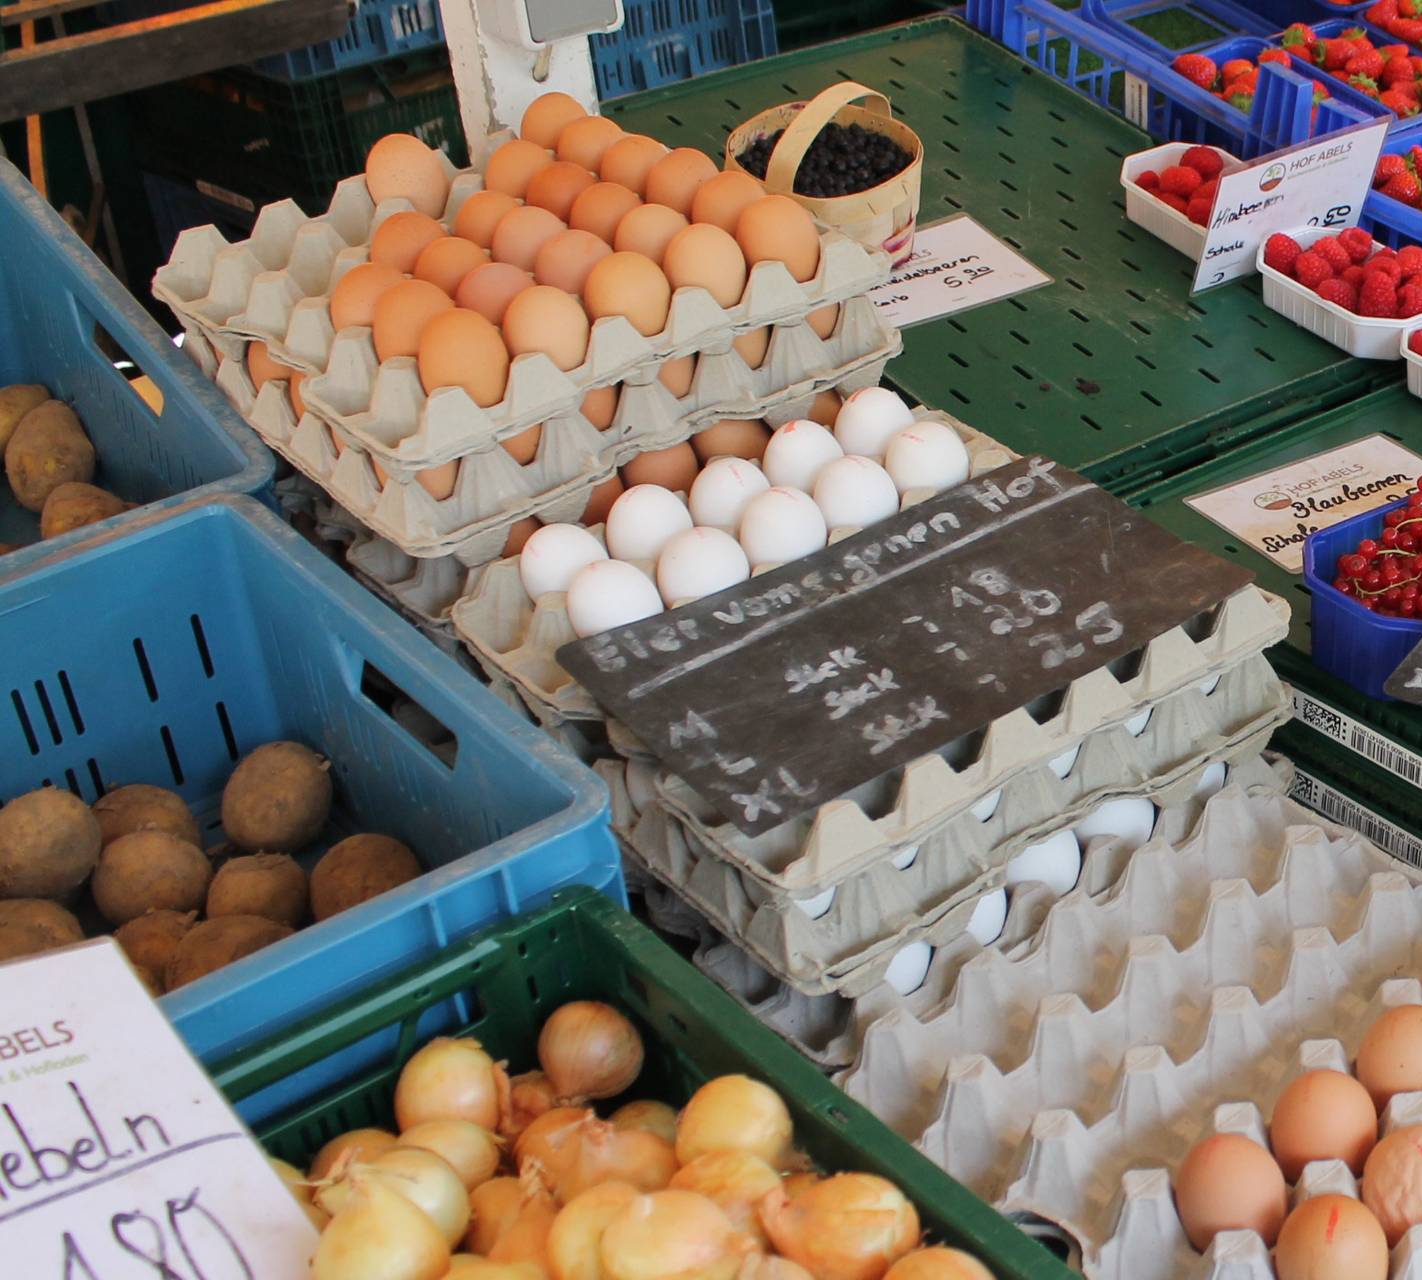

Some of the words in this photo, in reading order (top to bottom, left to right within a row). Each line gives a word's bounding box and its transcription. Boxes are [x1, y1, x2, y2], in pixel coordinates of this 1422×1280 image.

[1289, 153, 1317, 172] HOF
[1316, 141, 1353, 162] ABELS
[973, 456, 1065, 513] Hof
[1287, 477, 1319, 496] HOF
[1320, 463, 1364, 483] ABELS
[730, 766, 819, 822] XL
[0, 1020, 75, 1060] BELS
[0, 1081, 171, 1199] ebeln
